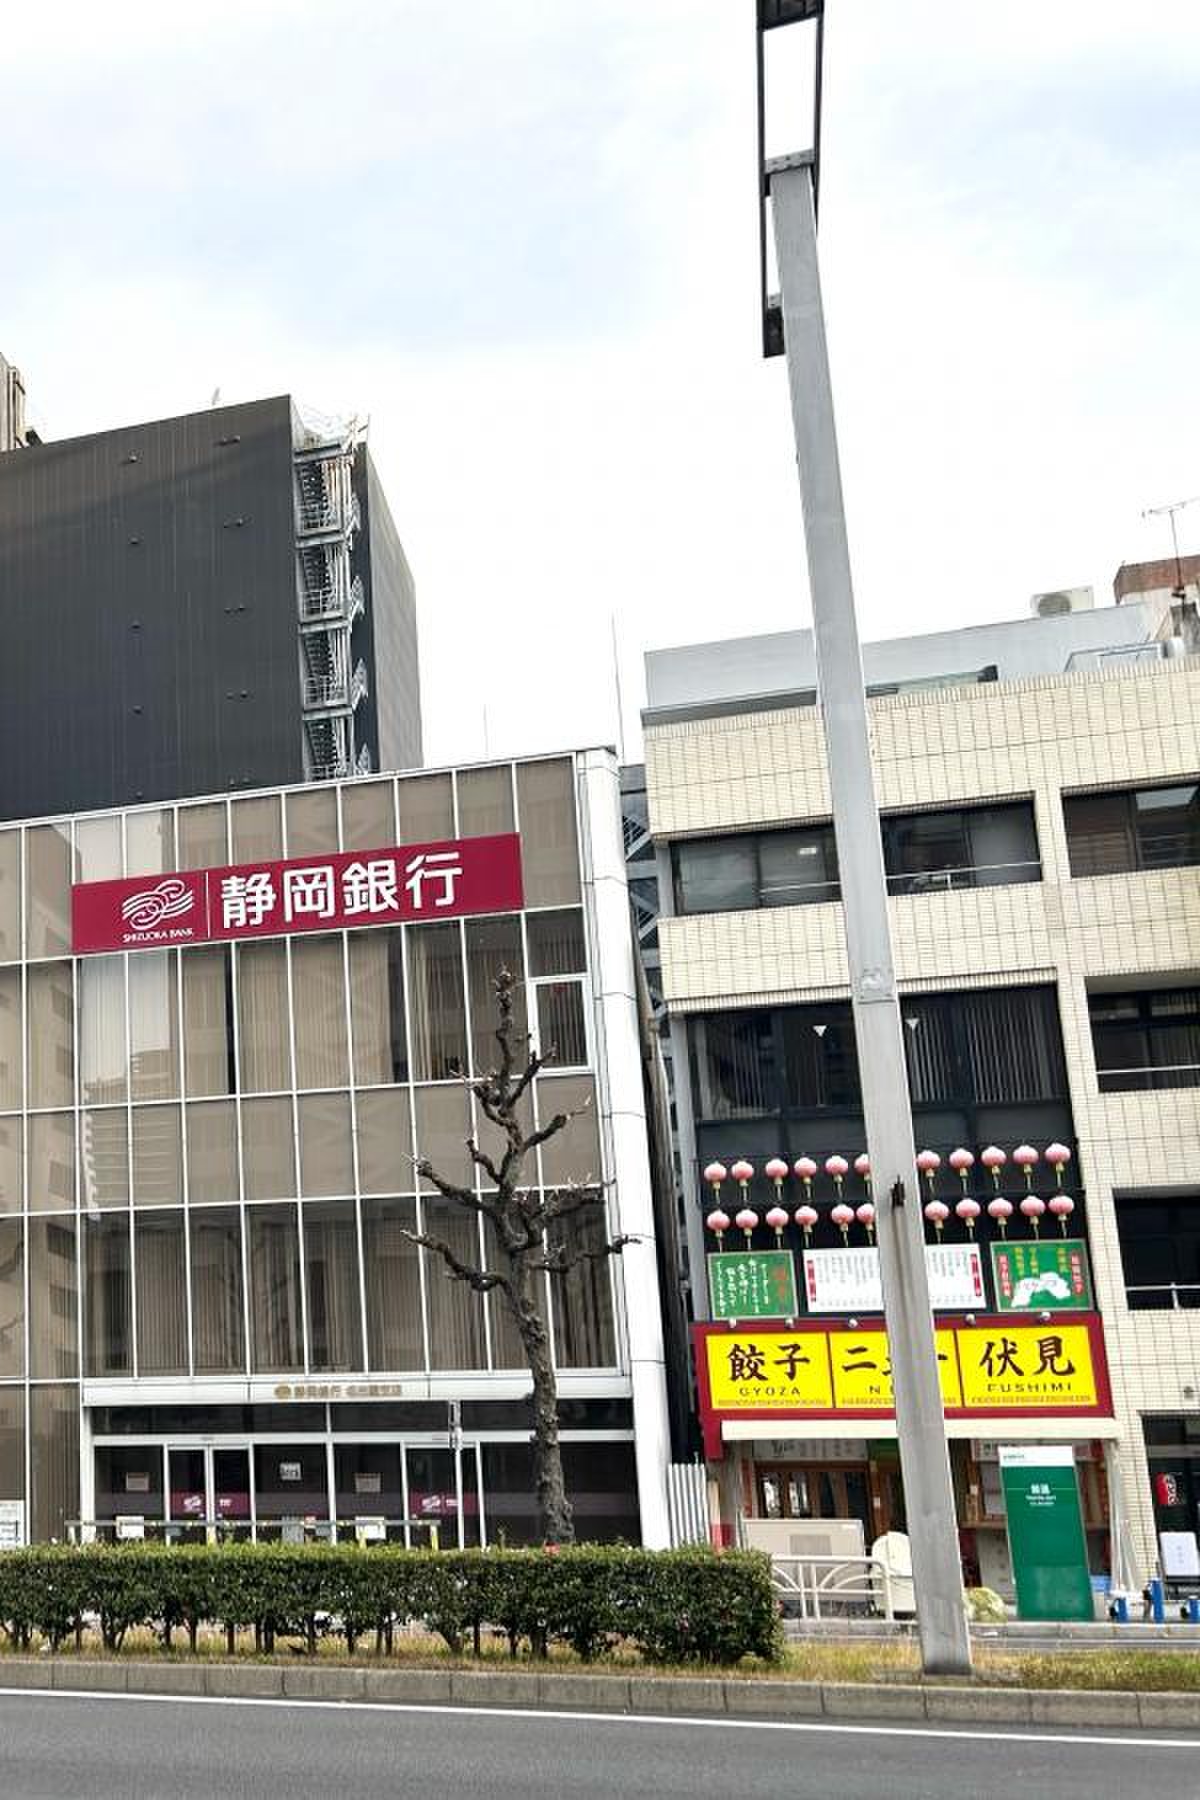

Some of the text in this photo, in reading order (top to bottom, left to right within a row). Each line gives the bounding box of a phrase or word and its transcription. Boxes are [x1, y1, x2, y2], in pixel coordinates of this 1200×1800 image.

[221, 852, 463, 928] 静岡銀行
[123, 928, 193, 943] SHIZUOKA BANK
[728, 1344, 810, 1381] 餃子
[979, 1335, 1076, 1377] 伏見
[739, 1386, 800, 1396] GYOZA
[987, 1382, 1071, 1392] FUSHIMI
